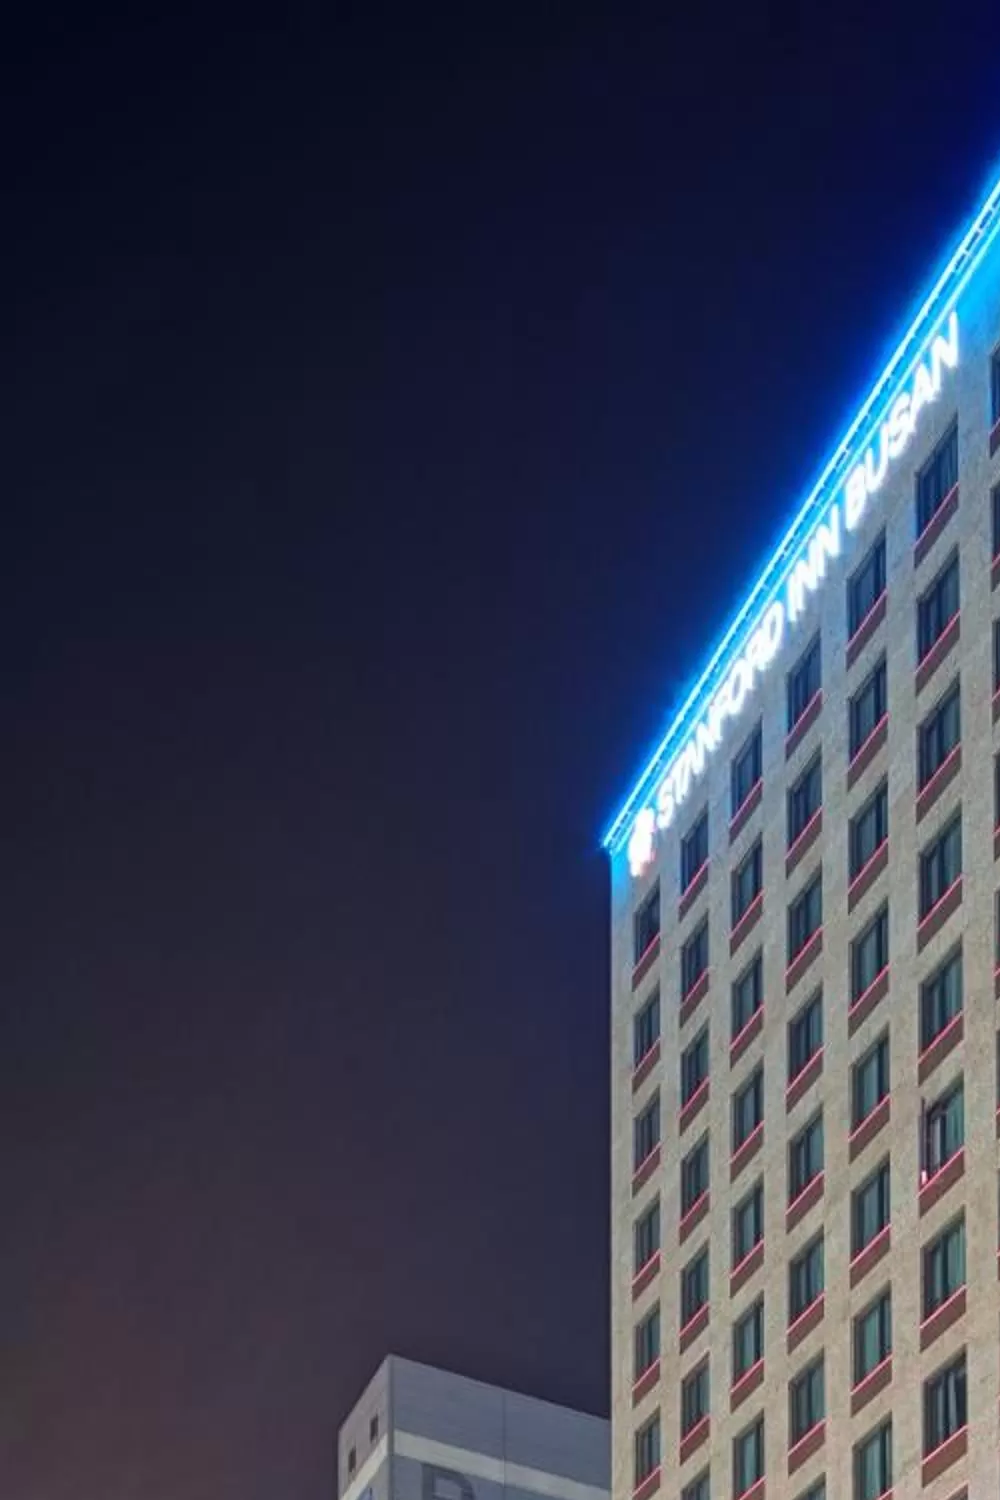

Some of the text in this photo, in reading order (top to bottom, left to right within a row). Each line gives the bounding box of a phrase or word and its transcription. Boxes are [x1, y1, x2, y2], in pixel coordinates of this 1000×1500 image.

[657, 310, 959, 828] STANFORD INN BUSAN
